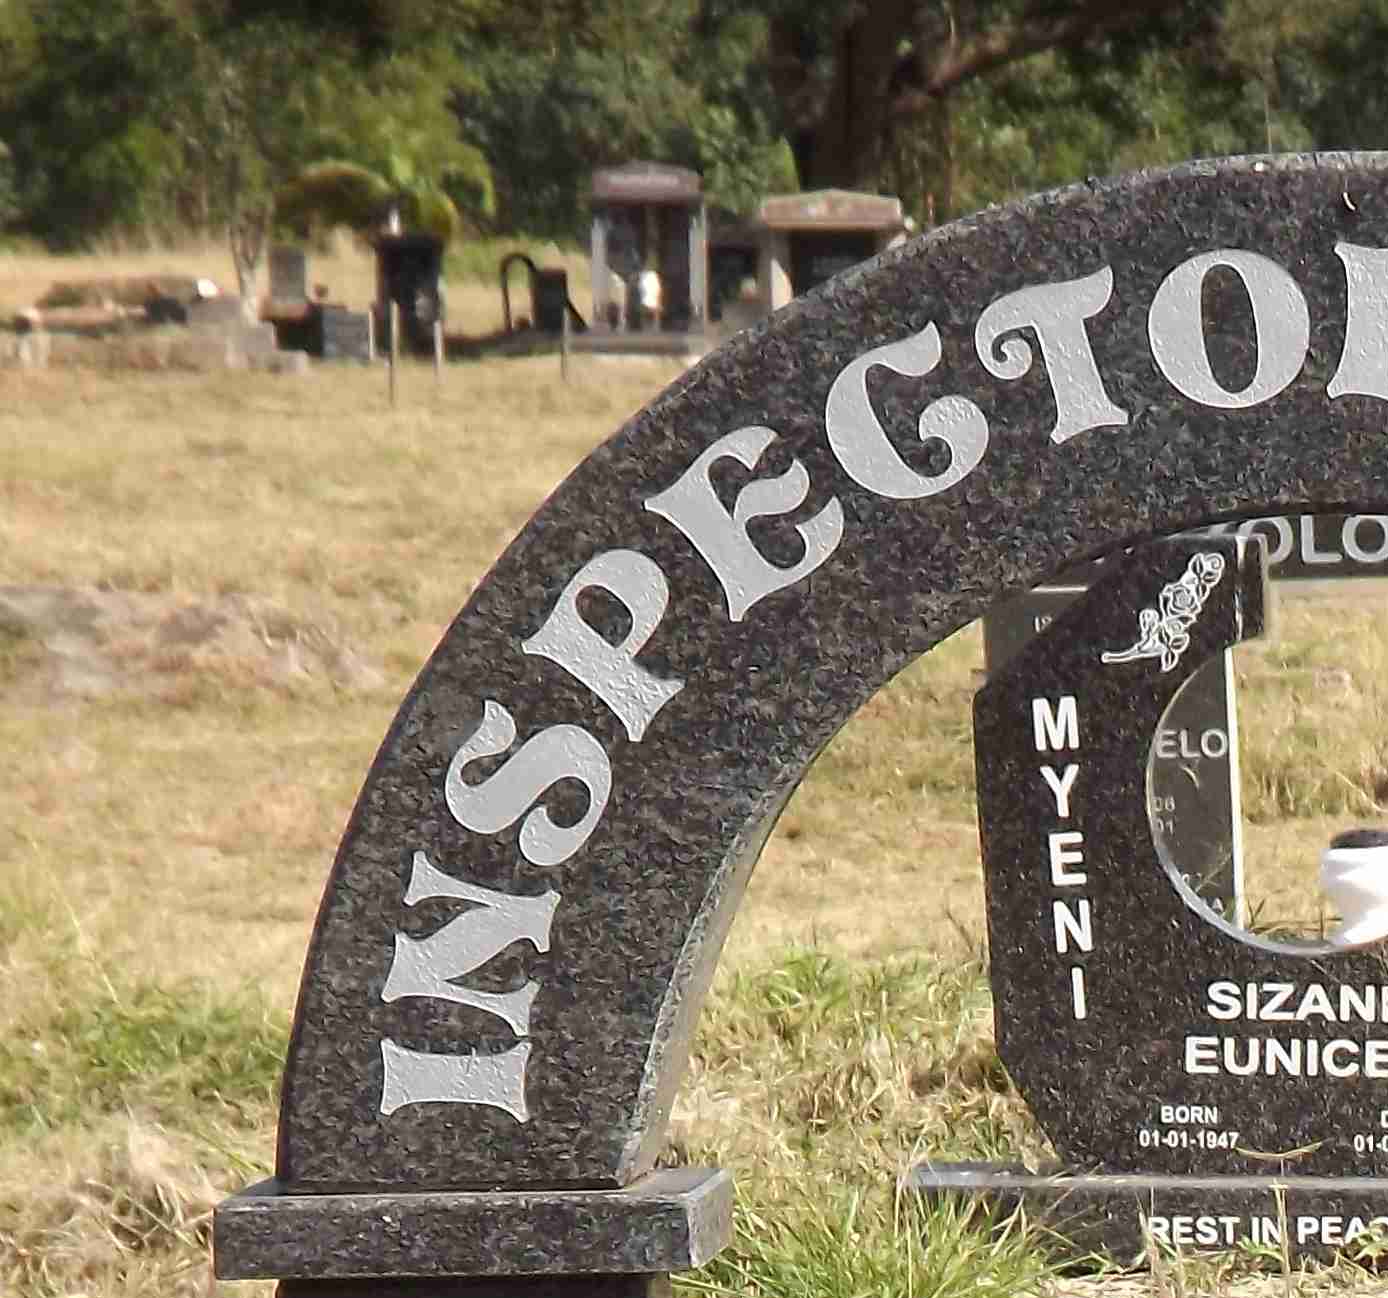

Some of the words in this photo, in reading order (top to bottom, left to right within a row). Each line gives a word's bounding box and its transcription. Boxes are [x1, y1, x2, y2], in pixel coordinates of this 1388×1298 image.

[1032, 695, 1093, 1020] MYENI
[1160, 1105, 1219, 1125] BORN
[1139, 1129, 1240, 1150] 01-01-1947
[1150, 1215, 1241, 1245] REST
[1251, 1216, 1283, 1246] IN
